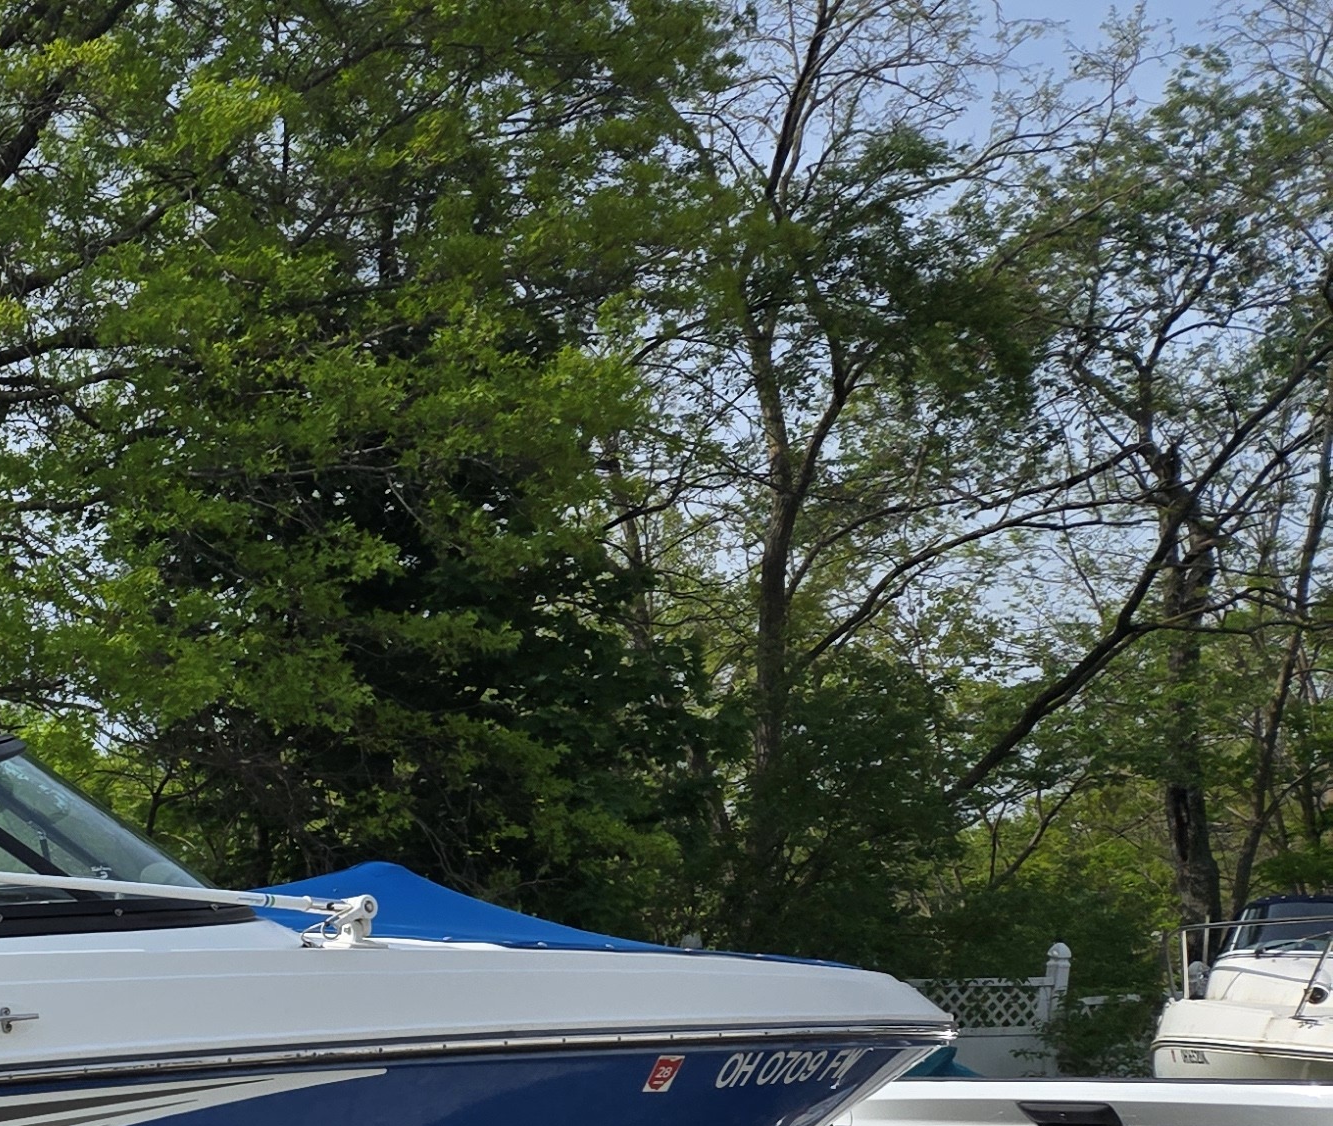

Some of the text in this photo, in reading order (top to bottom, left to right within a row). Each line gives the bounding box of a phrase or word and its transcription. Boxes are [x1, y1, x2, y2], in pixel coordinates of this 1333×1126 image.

[654, 1066, 673, 1078] 28
[715, 1051, 764, 1088] OH
[756, 1050, 828, 1085] 0709
